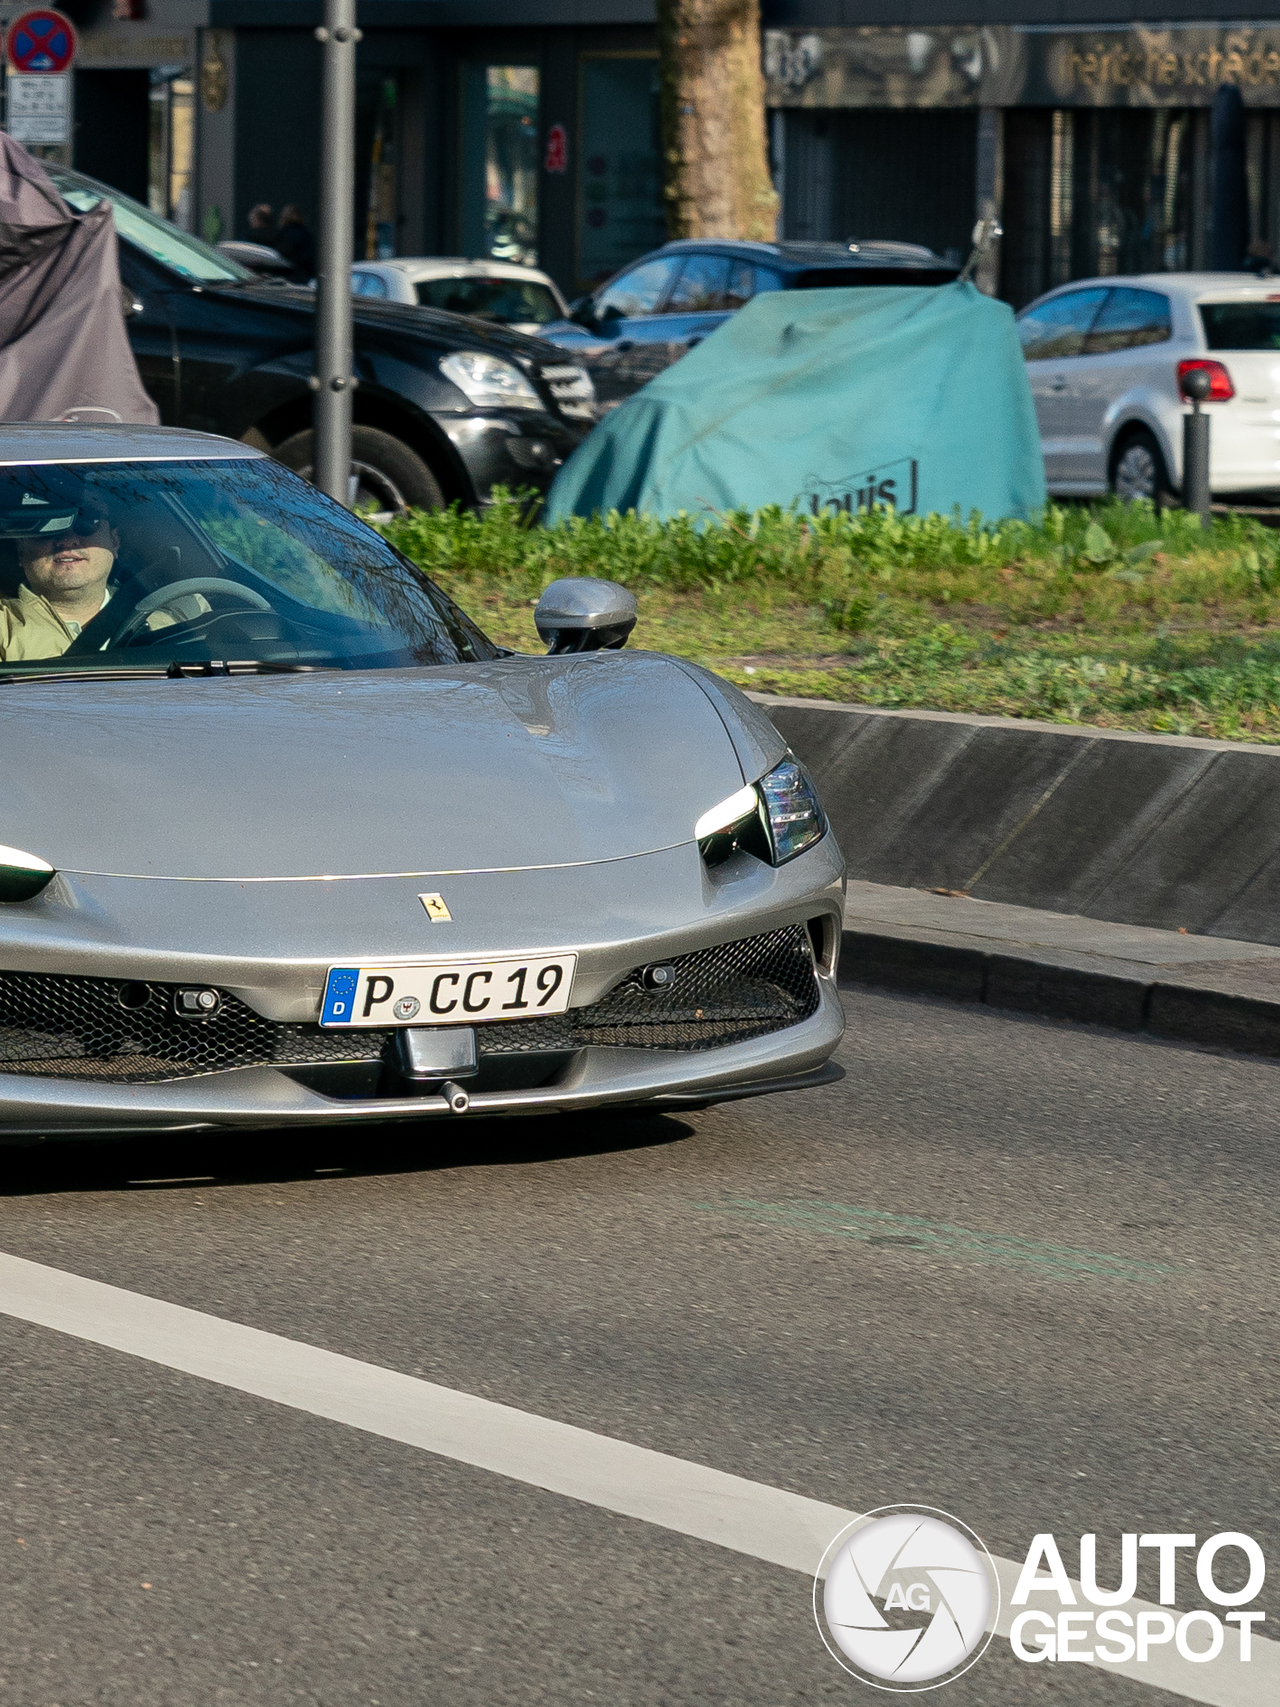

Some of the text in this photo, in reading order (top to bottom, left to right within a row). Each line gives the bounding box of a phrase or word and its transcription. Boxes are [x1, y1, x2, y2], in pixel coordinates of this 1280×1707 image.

[362, 975, 394, 1017] P
[429, 971, 493, 1014] CC
[501, 964, 563, 1011] 19
[332, 1002, 346, 1015] D
